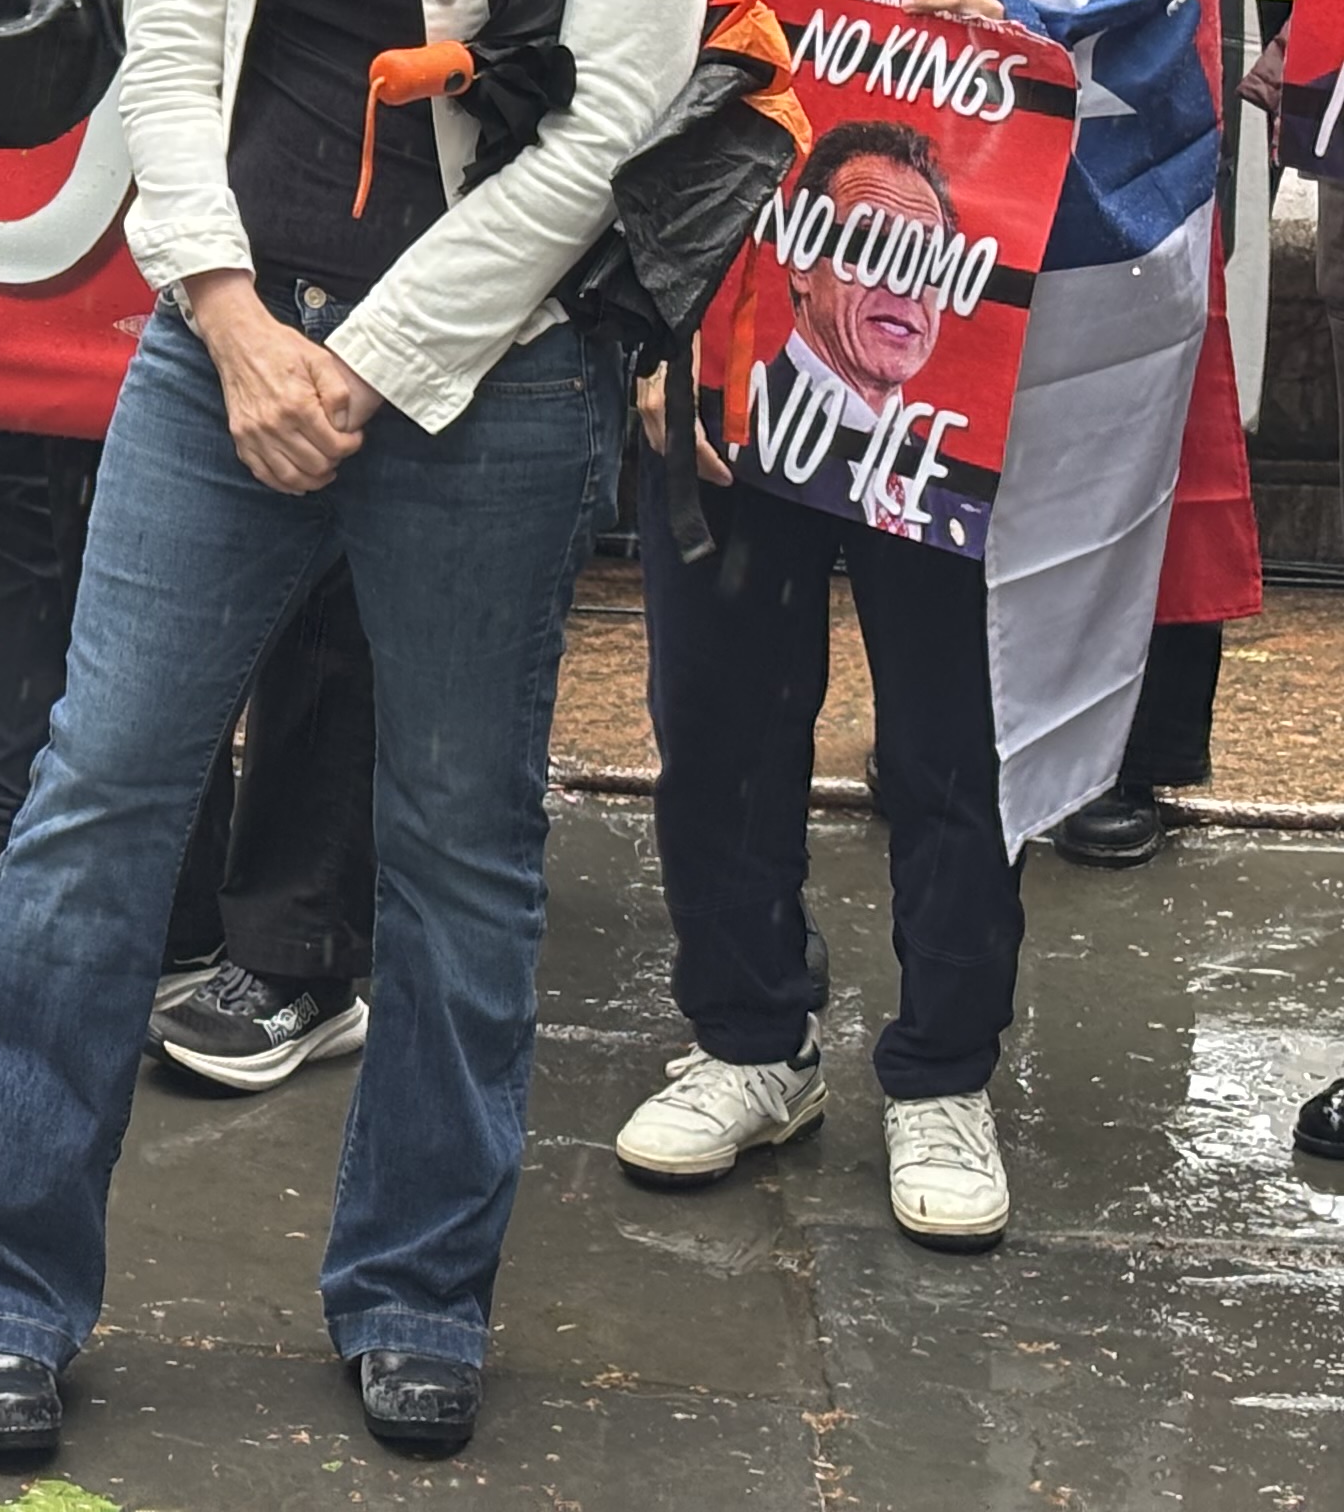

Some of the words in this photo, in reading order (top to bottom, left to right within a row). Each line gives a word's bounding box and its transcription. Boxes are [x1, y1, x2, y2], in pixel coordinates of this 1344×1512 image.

[790, 8, 871, 86] NO
[865, 24, 1029, 123] KINGS
[754, 187, 835, 271] NO
[832, 203, 999, 317] CUOMO
[730, 360, 846, 484] NO
[848, 394, 969, 524] ICE
